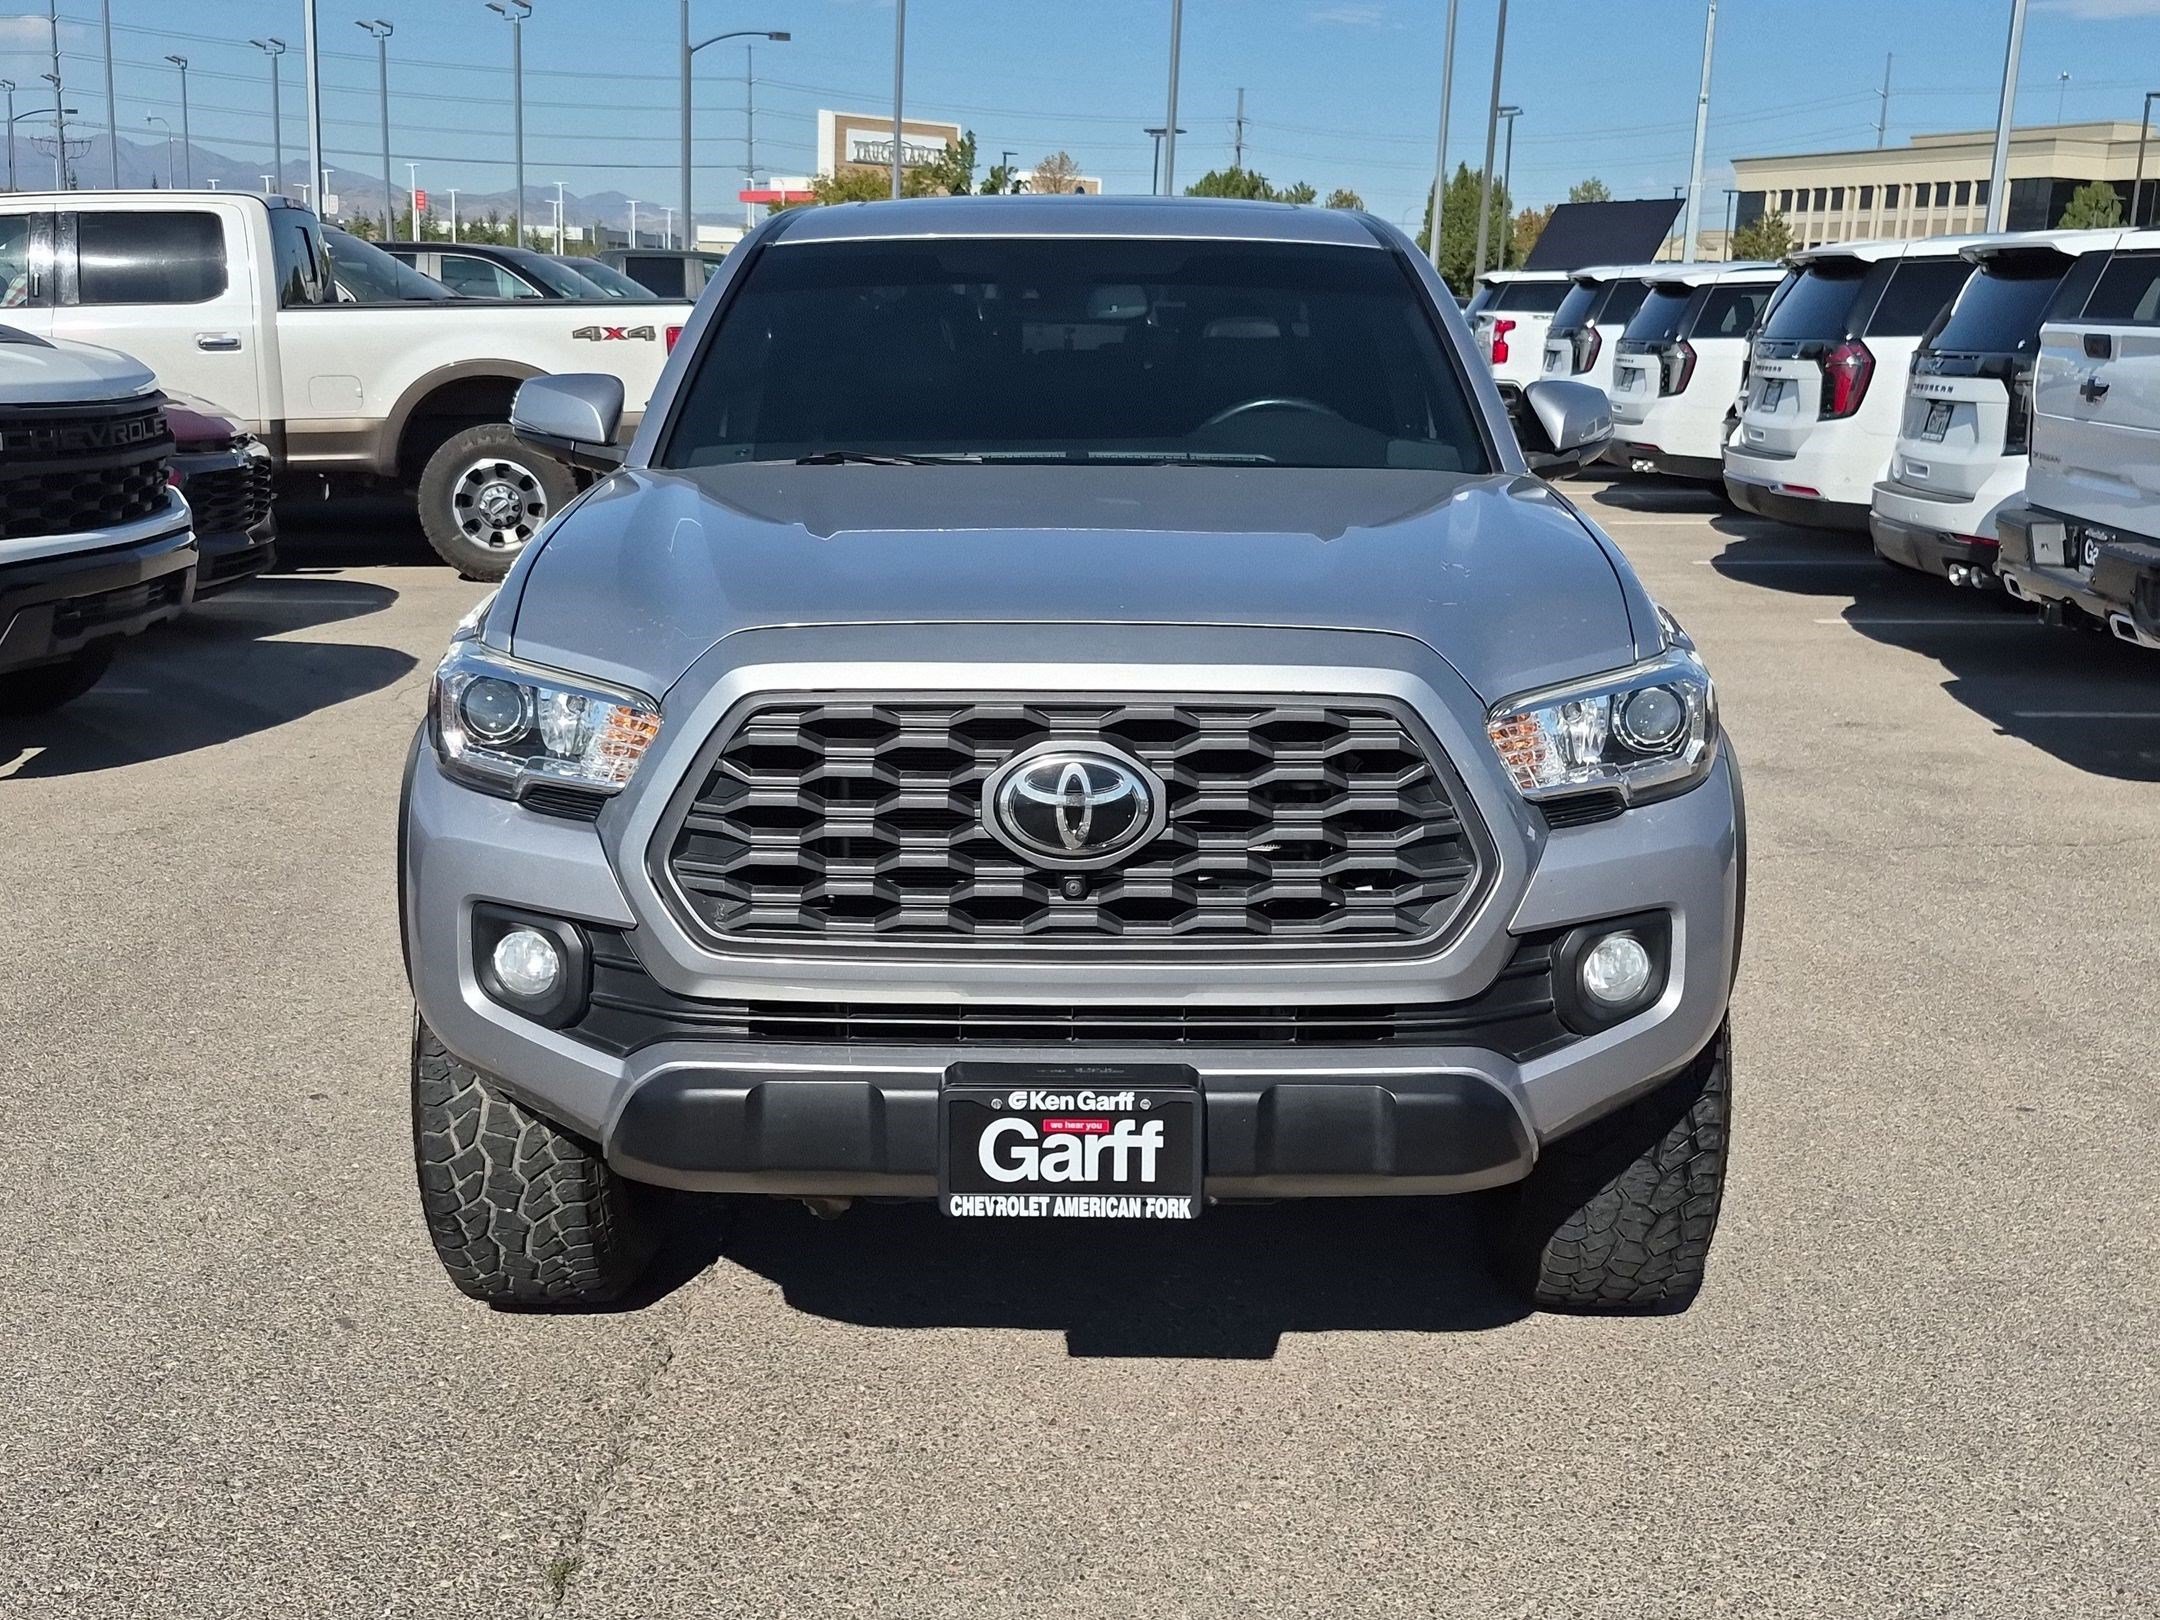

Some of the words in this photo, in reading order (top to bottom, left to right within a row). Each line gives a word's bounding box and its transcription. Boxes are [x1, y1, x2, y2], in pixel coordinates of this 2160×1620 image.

[2, 415, 168, 450] CHEVROLE
[1029, 1091, 1075, 1110] Ken
[1077, 1091, 1135, 1111] Garff
[1050, 1122, 1063, 1130] we
[1065, 1121, 1083, 1130] hear
[1085, 1122, 1103, 1131] you
[978, 1118, 1164, 1183] Garff
[950, 1196, 1050, 1217] CHEVROLET
[1053, 1197, 1142, 1218] AMERICAN
[1145, 1198, 1192, 1219] FORK
